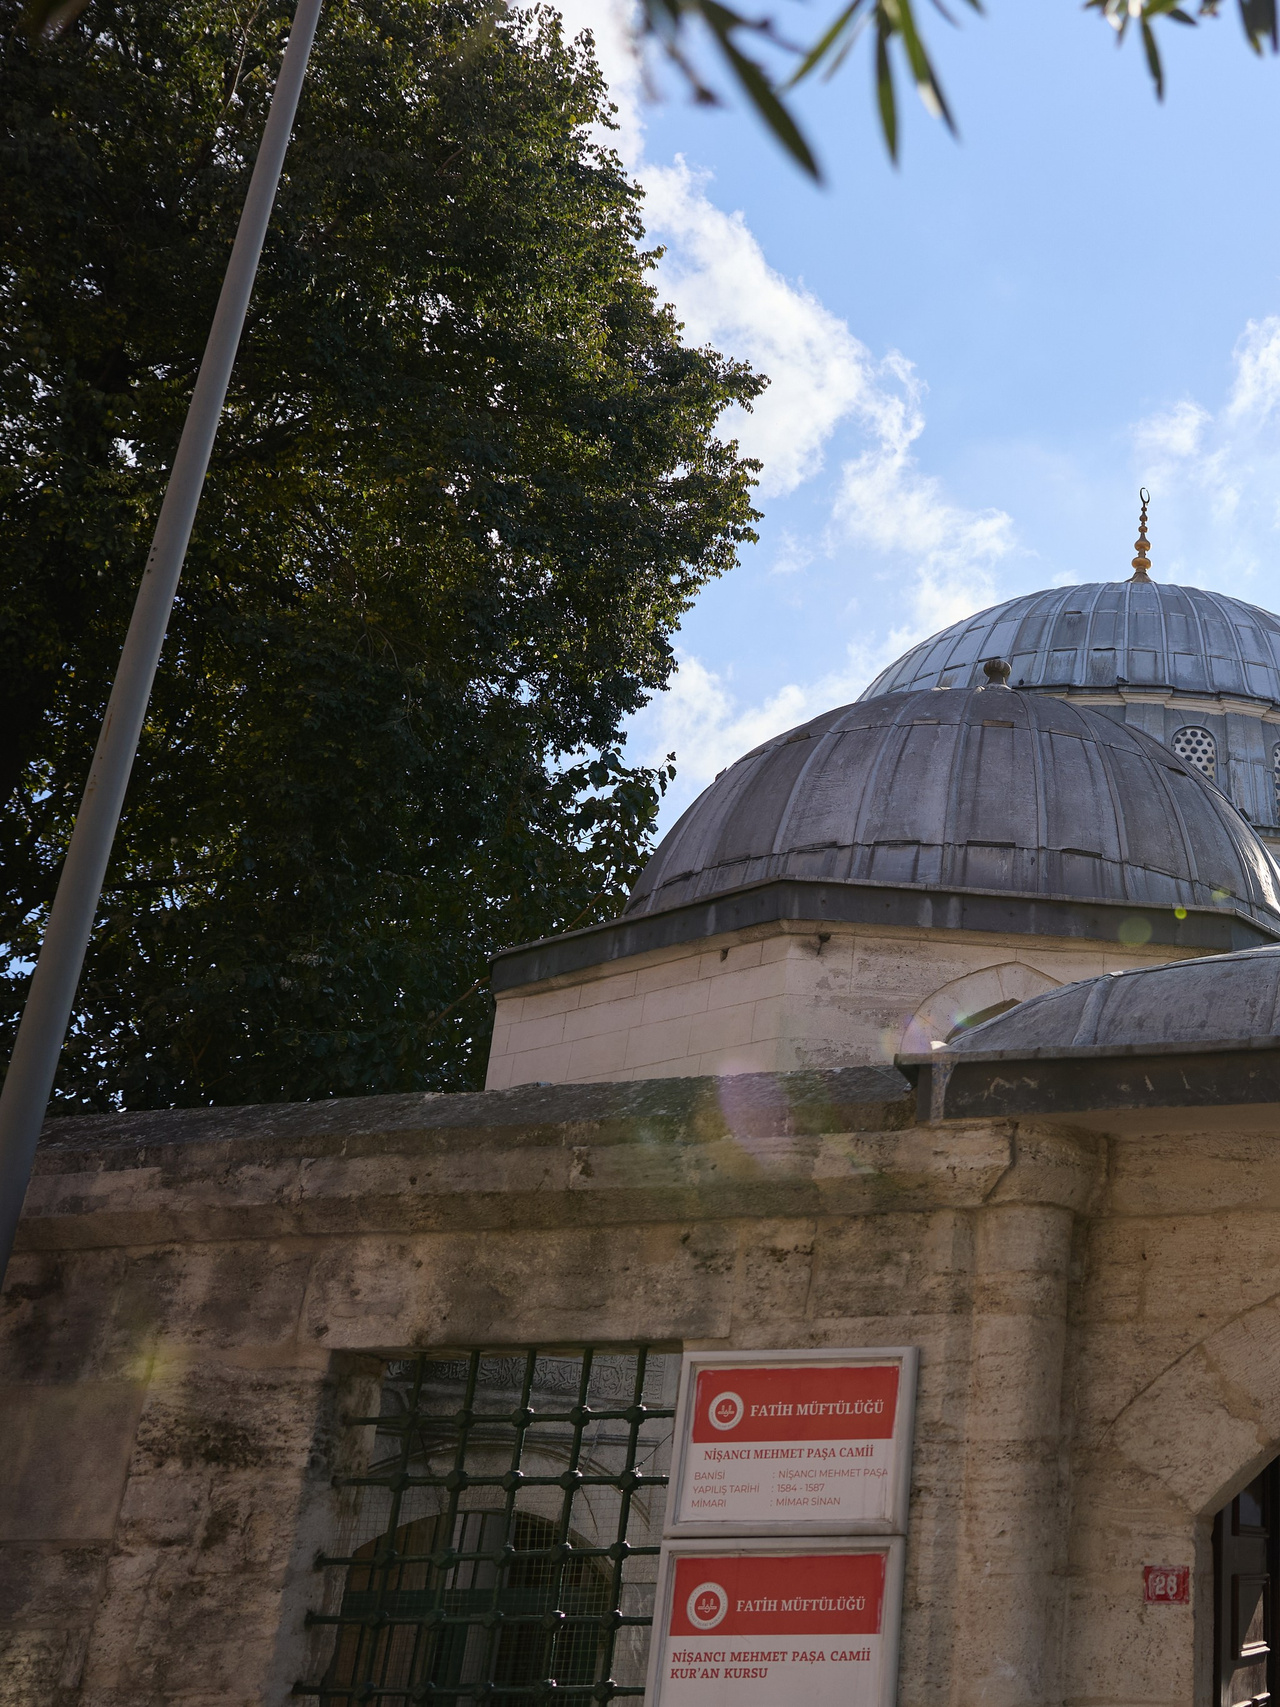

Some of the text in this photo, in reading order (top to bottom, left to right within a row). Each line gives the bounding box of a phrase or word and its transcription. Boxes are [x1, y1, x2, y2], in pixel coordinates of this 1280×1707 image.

[750, 1401, 794, 1417] FATİH
[796, 1399, 884, 1416] MÜFTÜLÜĞÜ
[703, 1444, 874, 1463] NİŞANCI MEHMET PAŞA CAMİİ
[694, 1469, 726, 1480] BANİSİ
[778, 1469, 817, 1480] NİŞANCI
[819, 1468, 861, 1478] MEHMET
[863, 1468, 888, 1479] PAŞA
[693, 1485, 727, 1495] YAPILIŞ
[777, 1484, 797, 1493] 1584
[805, 1483, 825, 1492] 1587
[776, 1497, 809, 1506] MİMAR
[811, 1496, 841, 1506] SİNAN
[736, 1596, 866, 1612] FATİH MÜFTÜLÜĞÜ
[671, 1647, 871, 1665] NİŞANCI MEHMET PAŞA CAMİİ
[724, 1667, 768, 1679] KURSU
